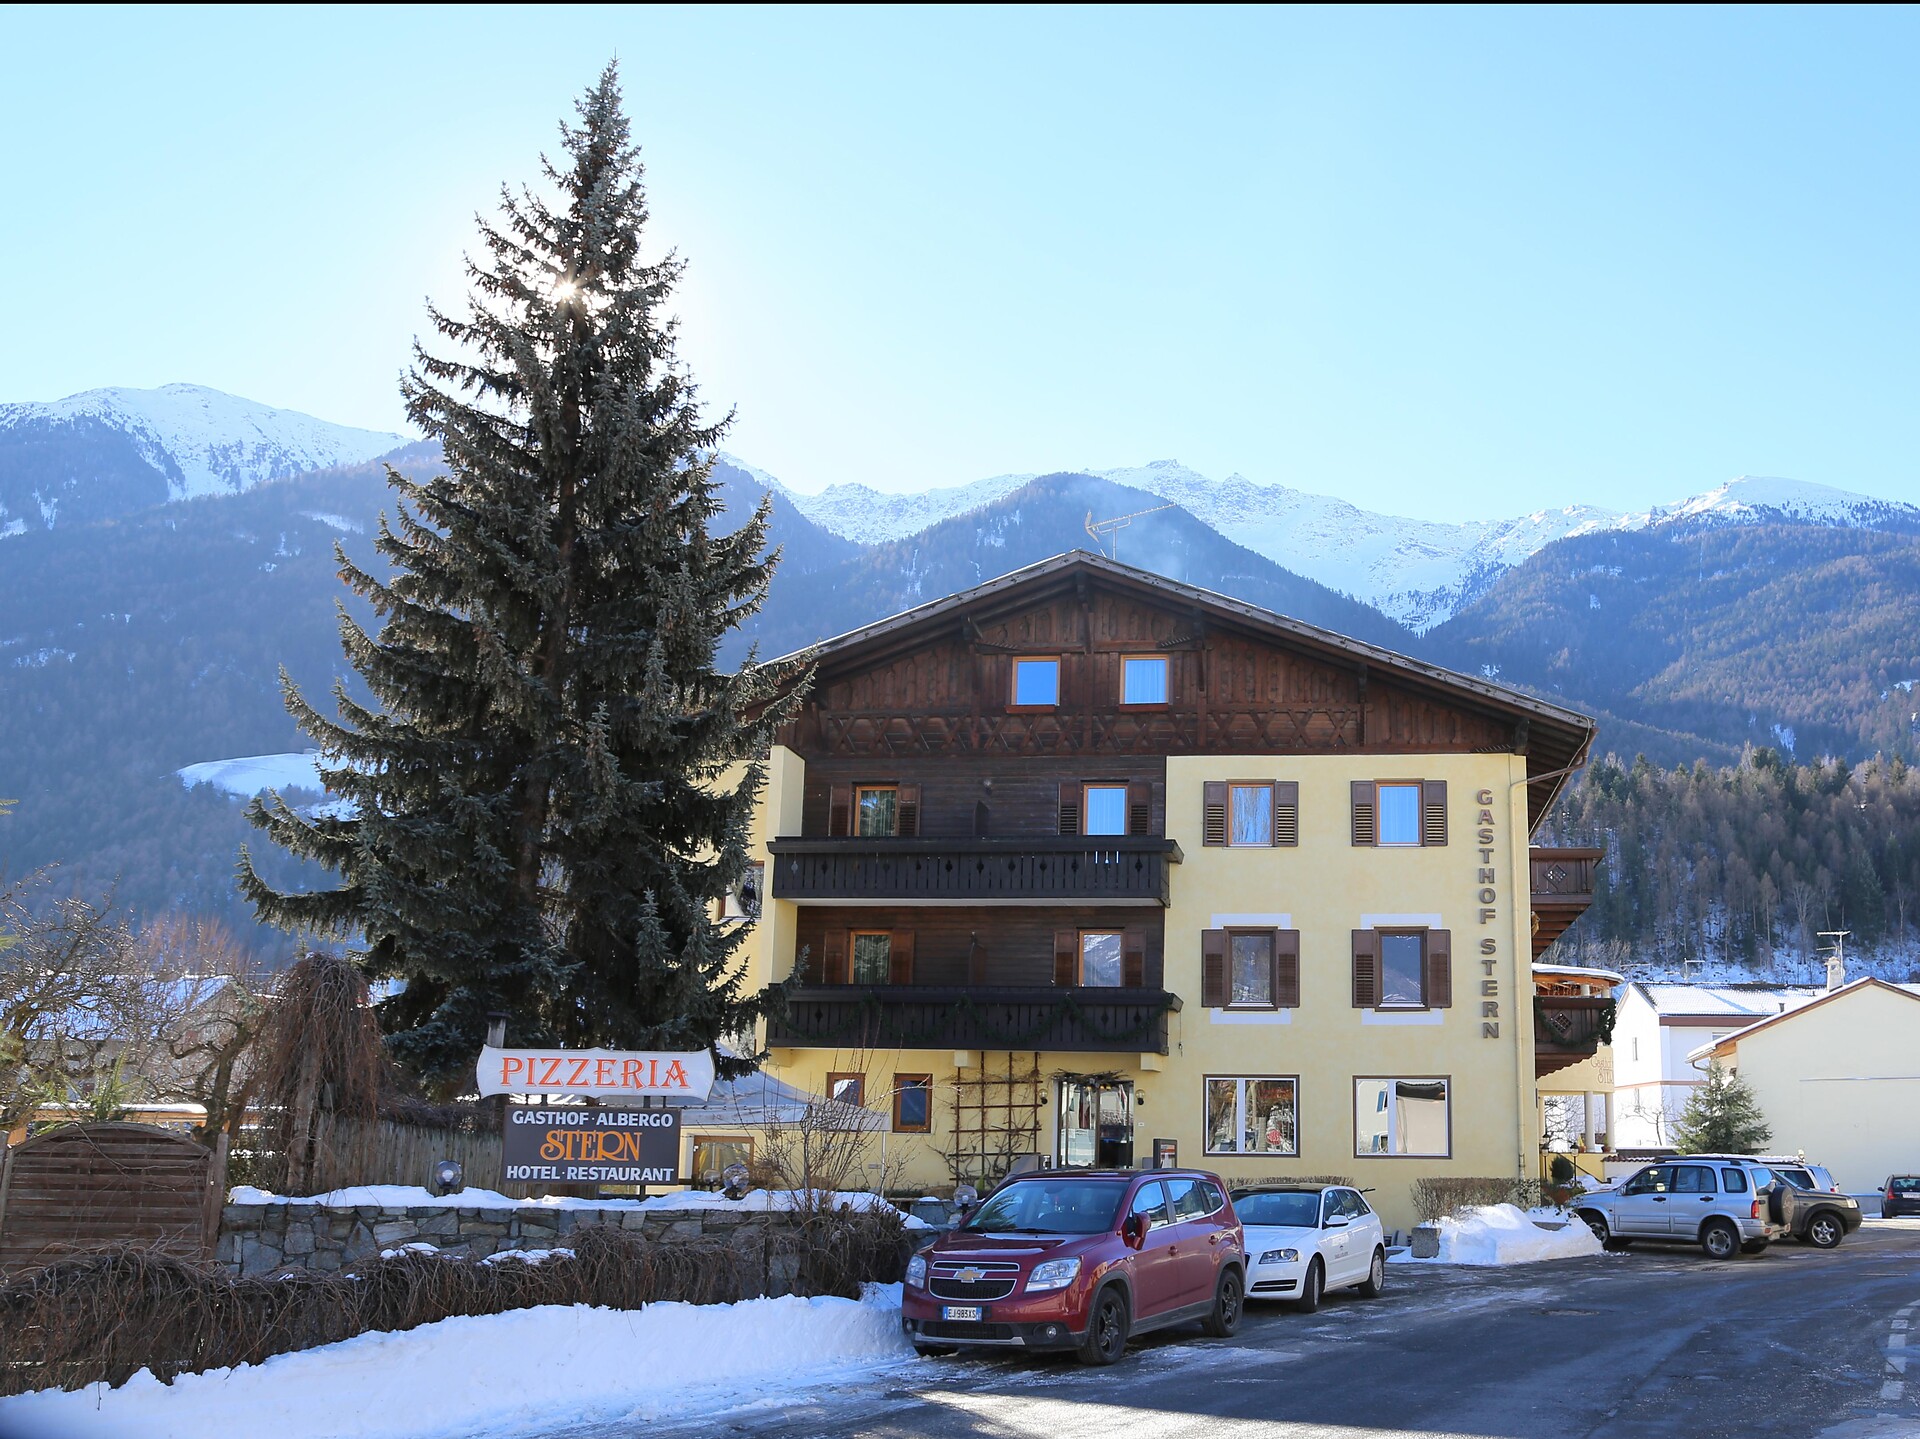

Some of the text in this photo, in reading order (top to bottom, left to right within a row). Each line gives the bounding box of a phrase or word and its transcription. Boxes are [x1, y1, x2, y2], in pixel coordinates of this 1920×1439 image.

[1477, 789, 1500, 1039] GASTHOF STERN
[500, 1057, 692, 1090] PIZZERIA
[512, 1110, 673, 1127] GASTHOF ALBERGO
[540, 1128, 642, 1162] STERN
[506, 1165, 674, 1181] HOTEL RESTAURANT
